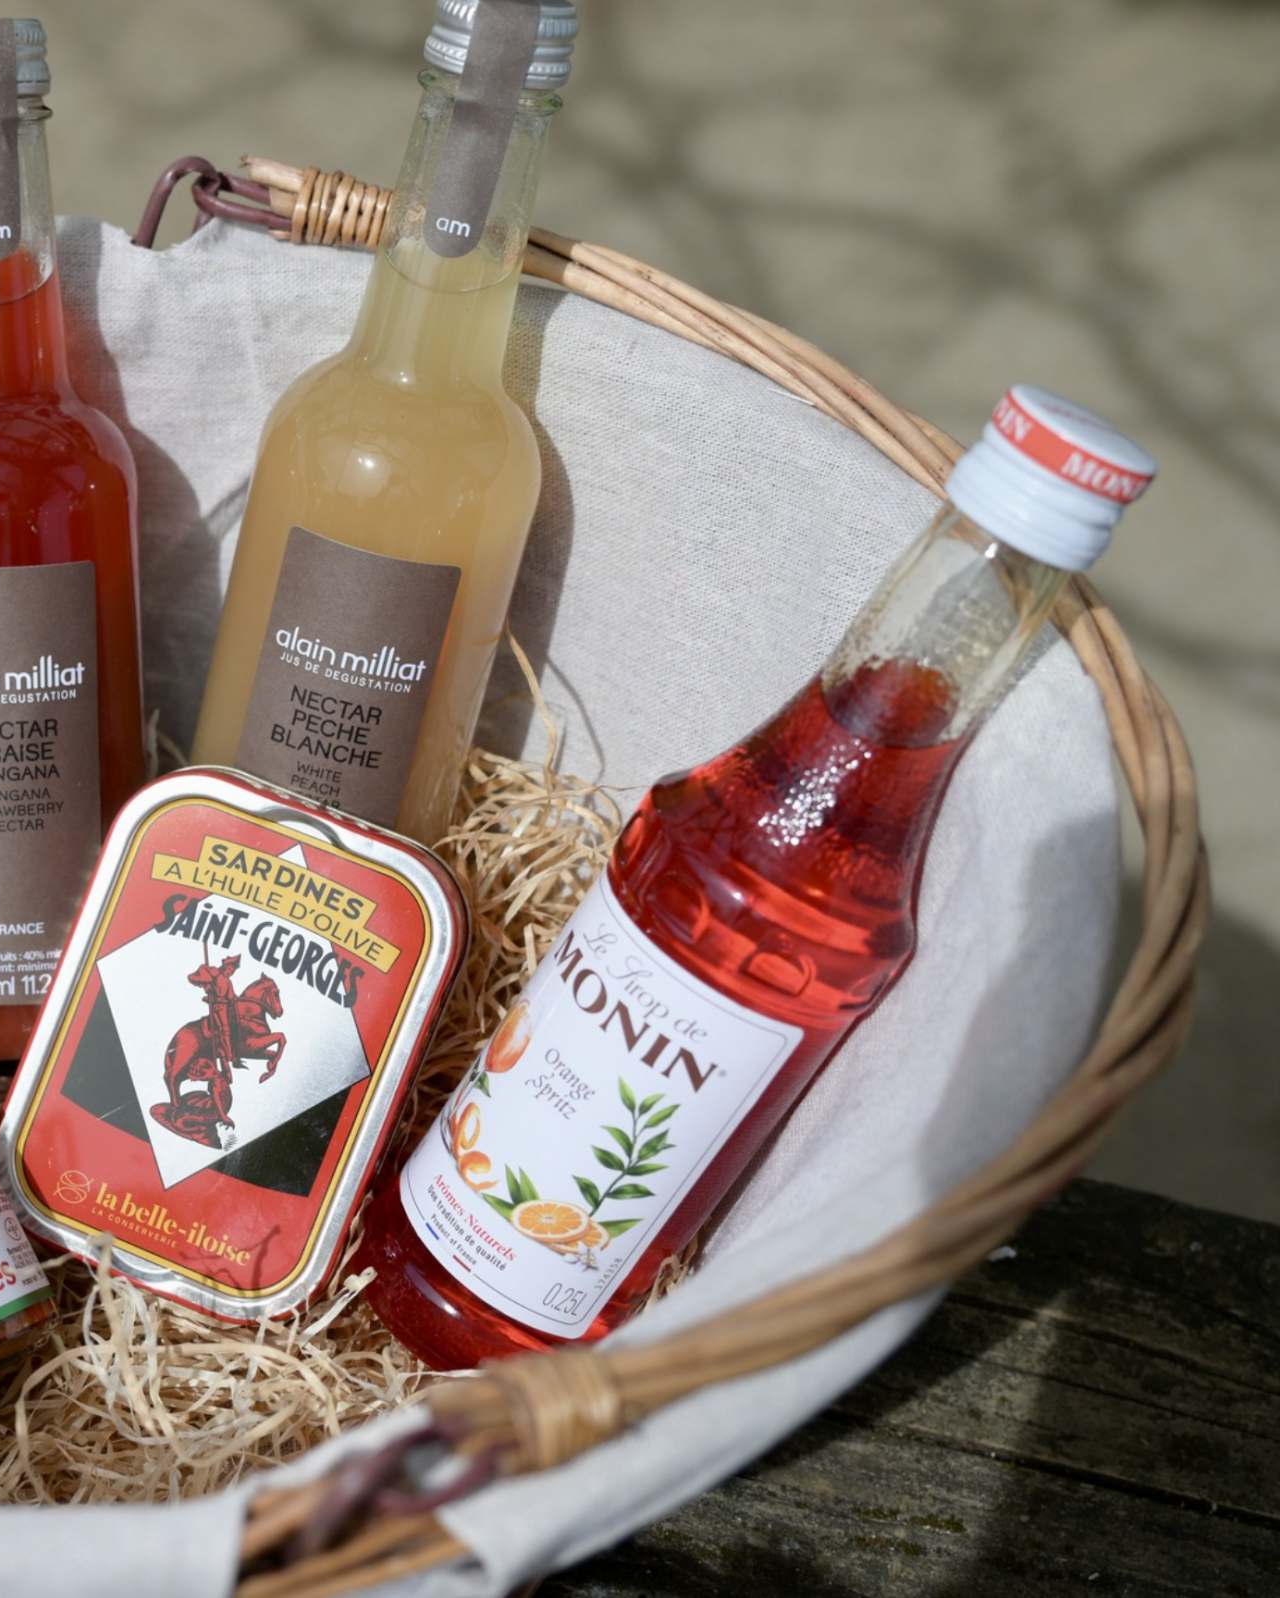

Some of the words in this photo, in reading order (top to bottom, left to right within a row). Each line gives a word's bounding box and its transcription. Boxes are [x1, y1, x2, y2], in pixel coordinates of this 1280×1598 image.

[436, 217, 470, 237] am
[4, 655, 85, 689] milliat
[275, 626, 336, 666] alain
[340, 646, 426, 681] milliat
[280, 652, 300, 668] JUS
[305, 661, 319, 675] DE
[325, 667, 412, 693] DEGUSTATION
[290, 684, 383, 726] NECTAR
[292, 709, 370, 745] PECHE
[271, 723, 382, 769] BLANCHE
[291, 774, 340, 797] PEACH
[297, 761, 342, 783] WHITE
[208, 844, 364, 920] SARDINES
[164, 862, 182, 880] A
[192, 867, 283, 911] L'HUILE
[289, 901, 384, 962] D'OLIVE
[17, 962, 57, 972] minimu
[583, 923, 618, 960] Le
[606, 955, 670, 1020] Sirop
[673, 1017, 708, 1044] de
[553, 928, 719, 1093] MONIN
[525, 1072, 577, 1120] Spritz
[544, 1048, 596, 1100] Orange
[91, 1207, 103, 1217] LA
[108, 1213, 178, 1248] CONSERVERIE
[95, 1182, 117, 1210] la
[120, 1192, 251, 1266] belle-iloise
[427, 1184, 438, 1202] Une
[437, 1200, 464, 1236] tradition
[465, 1235, 475, 1246] de
[475, 1244, 507, 1271] qualité
[430, 1213, 450, 1239] Product
[456, 1244, 477, 1266] France
[434, 1174, 465, 1216] Arômes
[464, 1213, 516, 1261] Naturels
